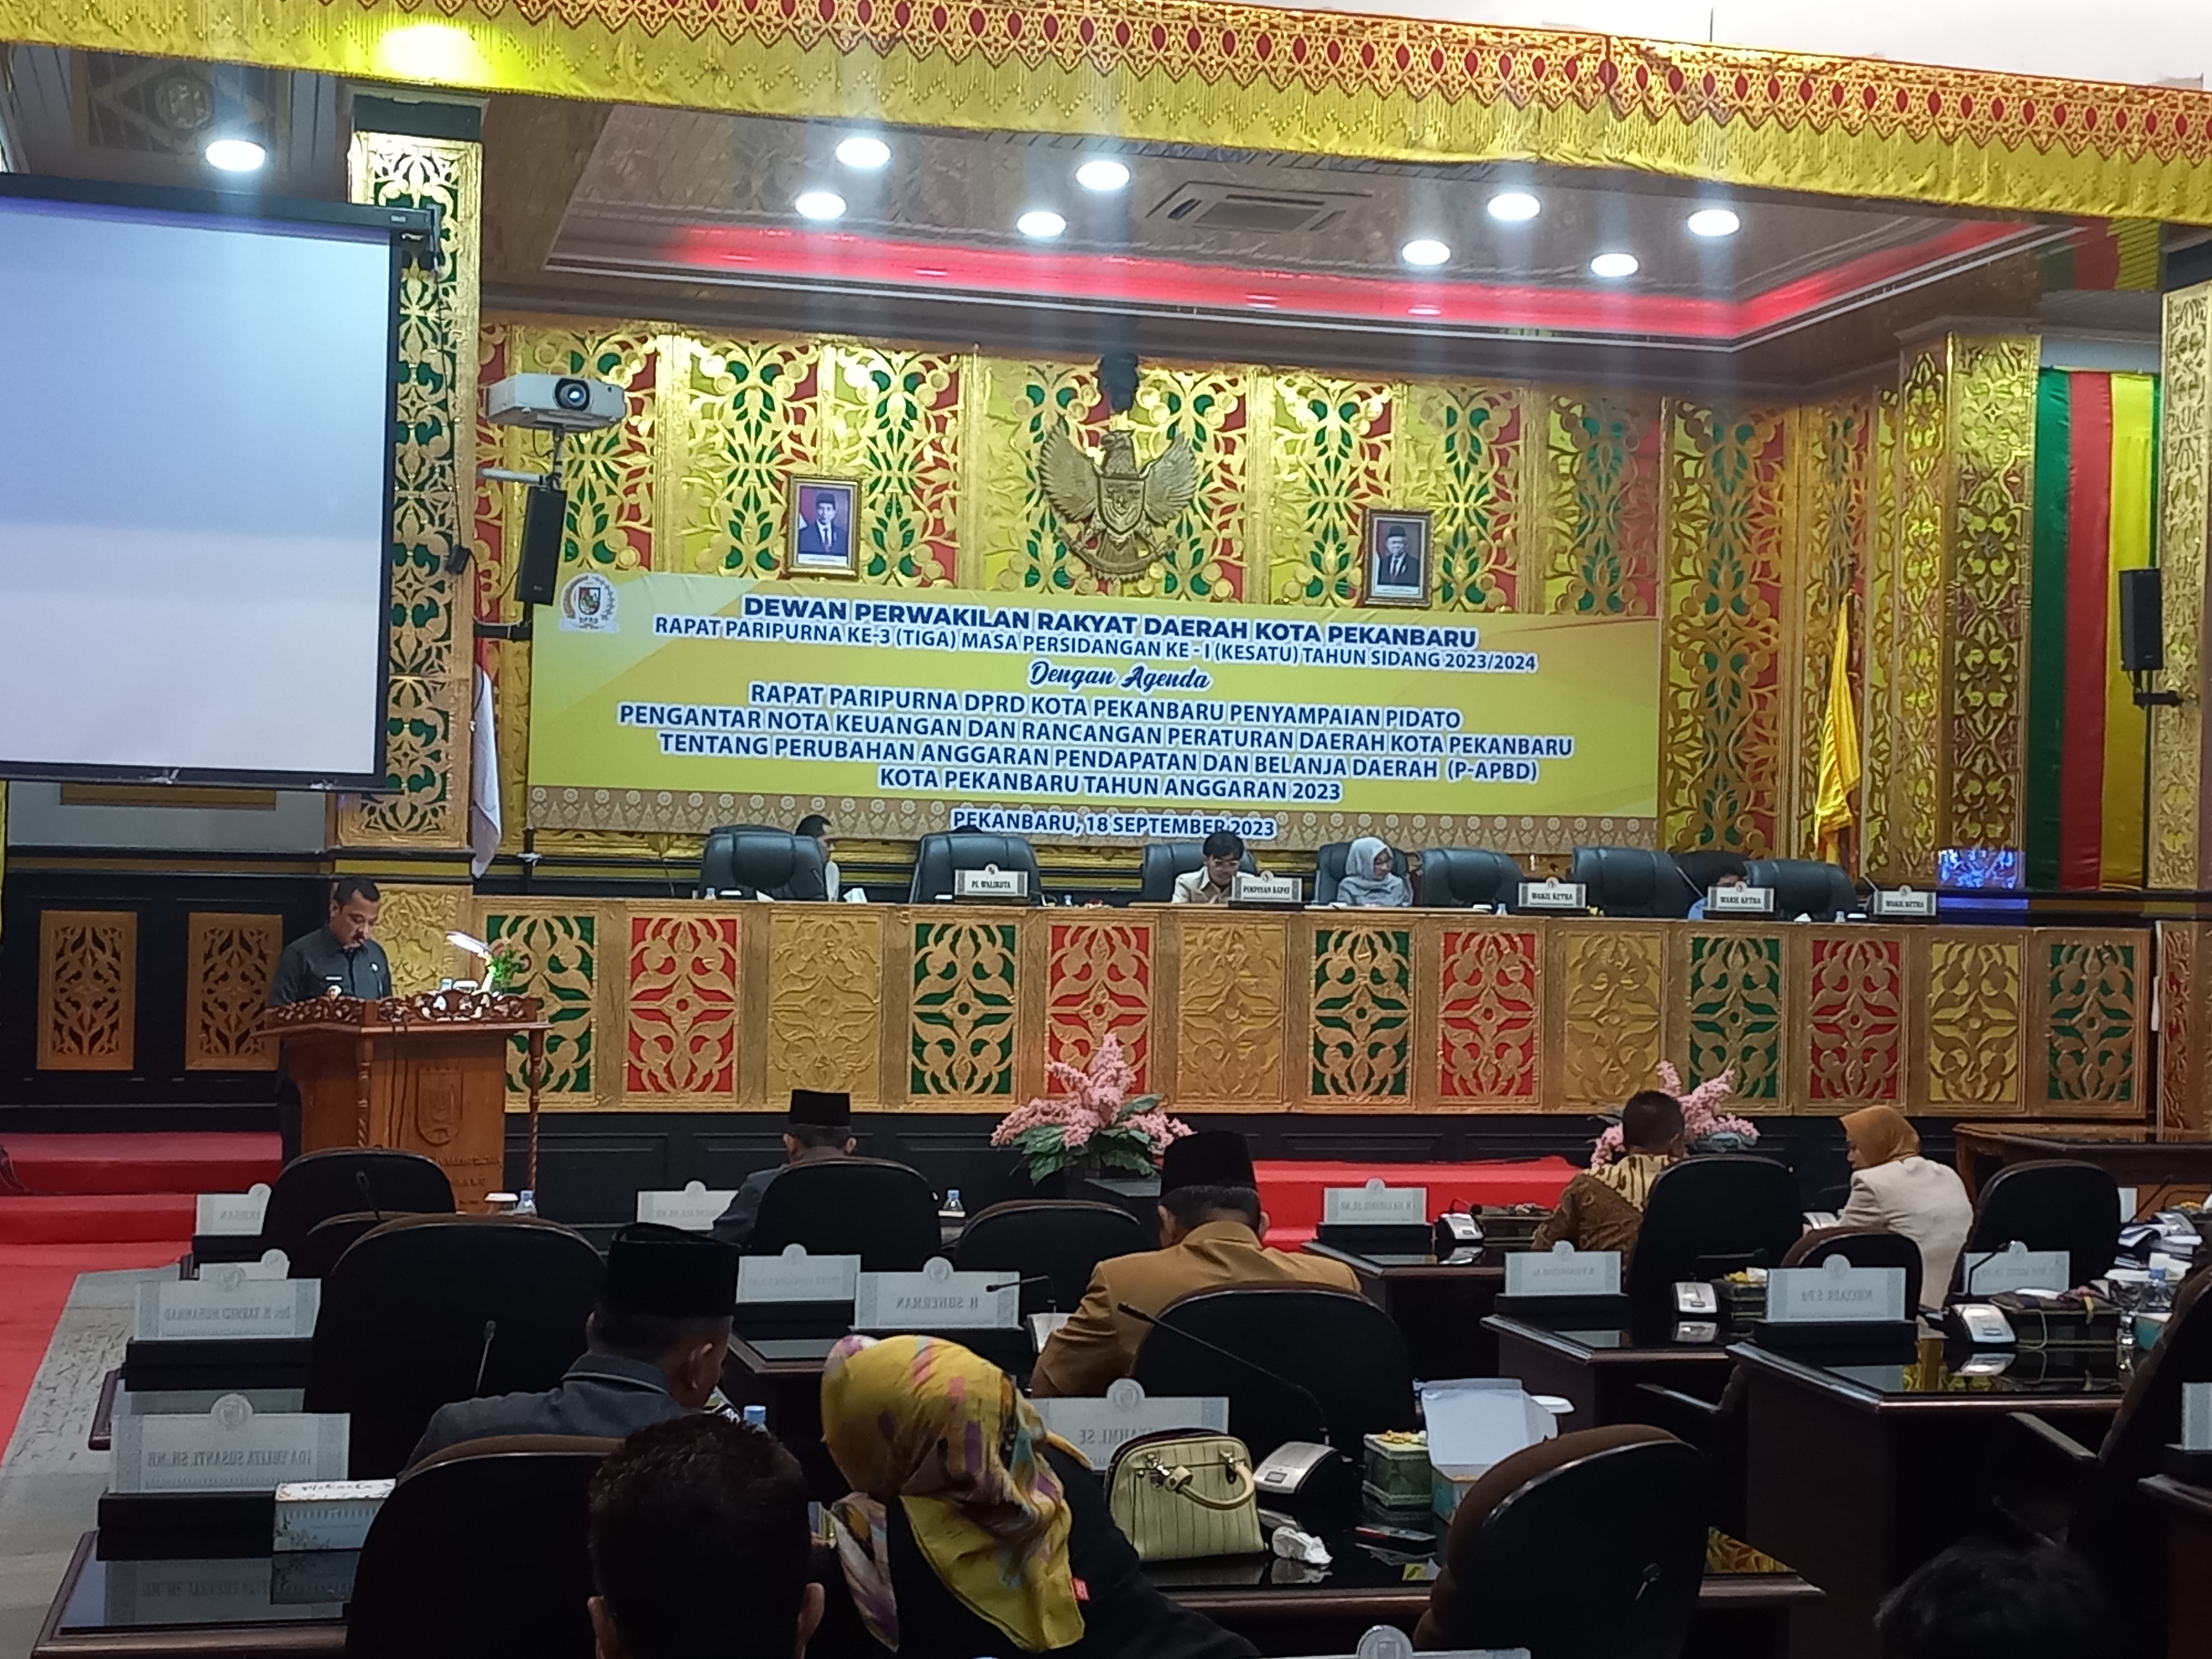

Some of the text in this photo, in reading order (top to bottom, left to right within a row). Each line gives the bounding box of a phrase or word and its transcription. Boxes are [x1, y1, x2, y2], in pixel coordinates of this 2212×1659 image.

[656, 617, 721, 635] RAPAT
[726, 620, 842, 642] PARIPURNA
[848, 627, 890, 644] KE-3
[896, 628, 956, 649] (TIGA)
[962, 633, 1018, 650] MASA
[1024, 635, 1161, 656] PERSIDANGAN
[1215, 643, 1298, 663] (KESATU)
[1302, 648, 1365, 665] TAHUN
[1371, 650, 1440, 667] SIDANG
[1445, 653, 1535, 670] 2023/2024
[745, 597, 1476, 648] DEWAN PERWAKILAN RAKYAT DAERAH KOTA PEKANBARU
[1030, 661, 1210, 692] Dengan Agenda
[752, 684, 1460, 728] RAPAT PARIPURNA DPRD KOTA PEKANBARU PENYAMPAIAN PIDATO
[620, 705, 1572, 755] PENGANTAR NOTA KEUANGAN DAN RANCANGAN PERATURAN DAERAH KOTA PEKANBARU
[660, 733, 1537, 781] TENTANG PERUBAHAN ANGGARAN PENDAPATAN DAN BELANJA DAERAH (P-APBD)
[881, 768, 1340, 800] KOTA PEKANBARU TAHUN ANGGARAN 2023
[954, 811, 1274, 836] PEKANBARU, 18 SEPTEMBER 2023
